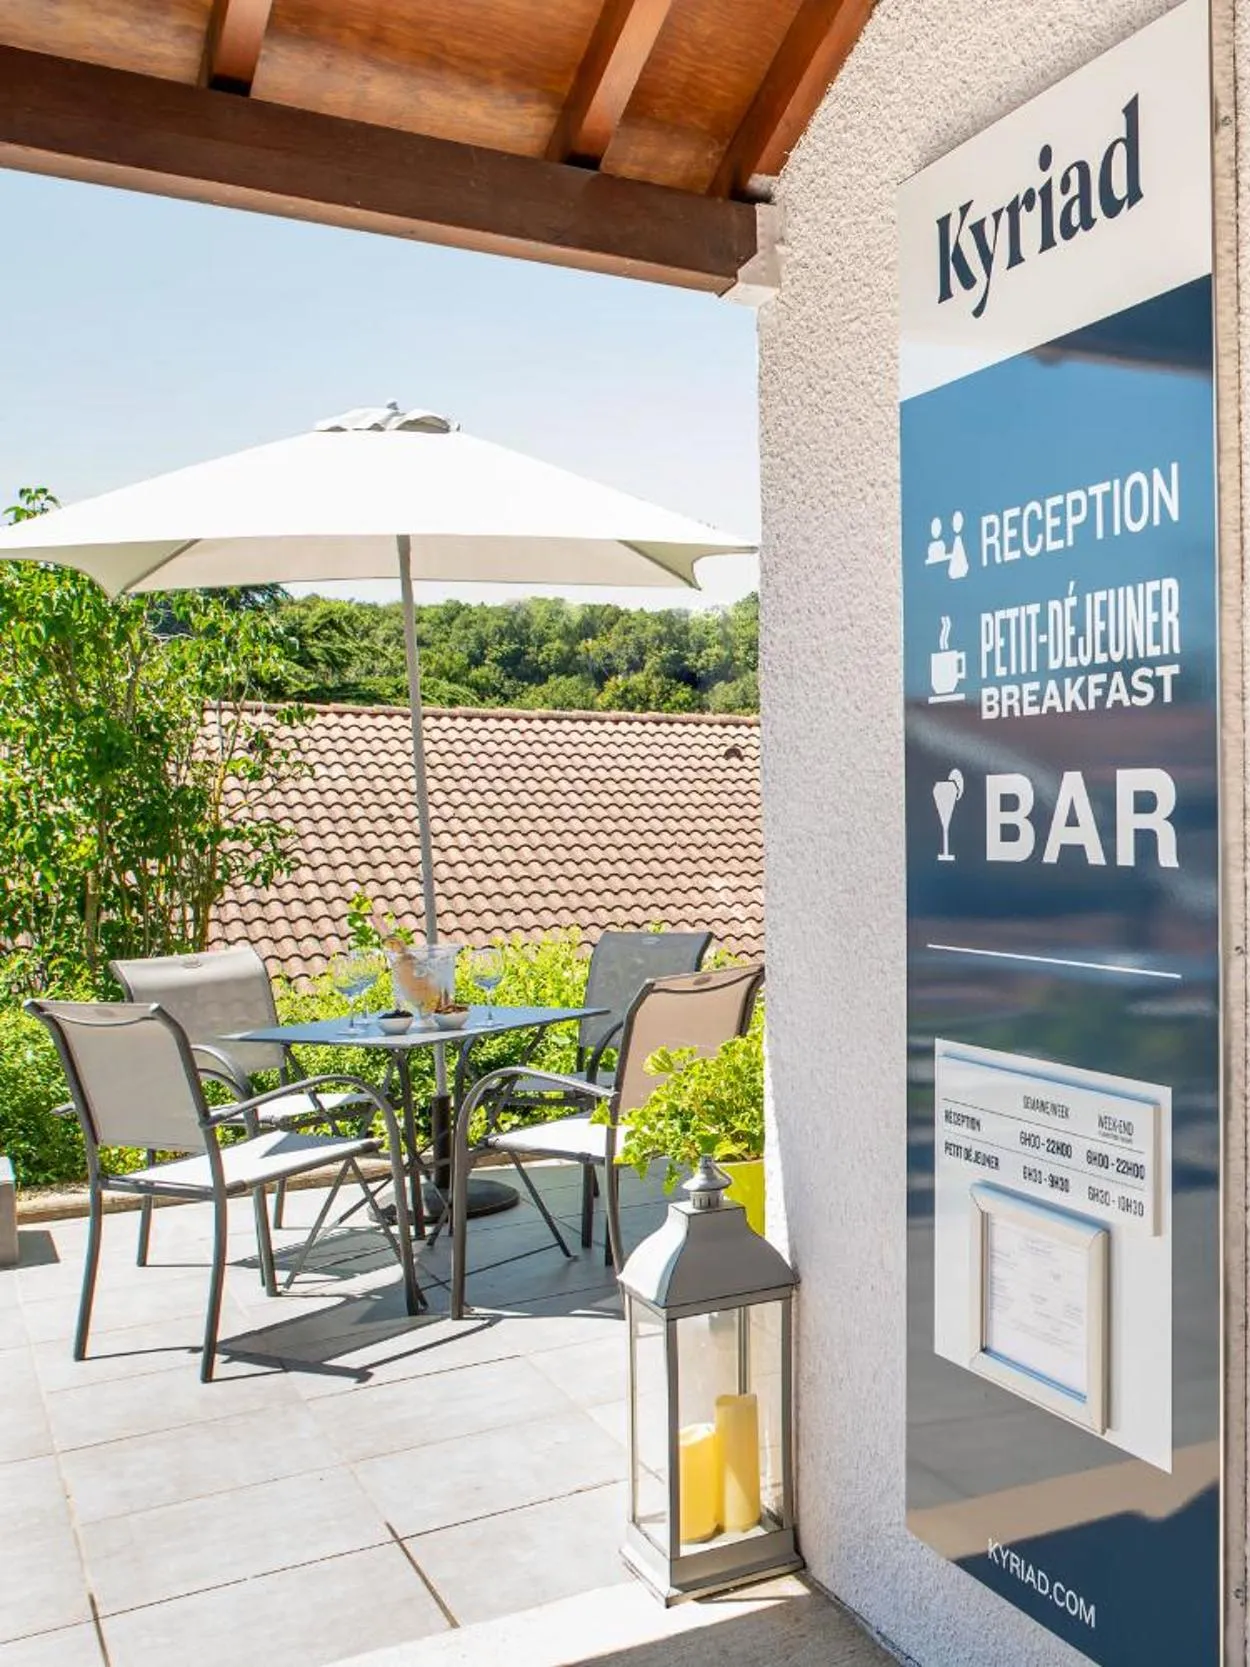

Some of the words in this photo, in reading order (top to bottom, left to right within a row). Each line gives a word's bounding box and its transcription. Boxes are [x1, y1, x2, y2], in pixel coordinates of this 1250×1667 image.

[936, 92, 1144, 319] Kyriad
[981, 462, 1180, 567] RECEPTION
[980, 577, 1181, 680] PETIT-DÉJEUNER
[981, 664, 1181, 720] BREAKFAST
[985, 768, 1180, 868] BAR
[987, 1538, 1096, 1629] KYRIAD.COM
